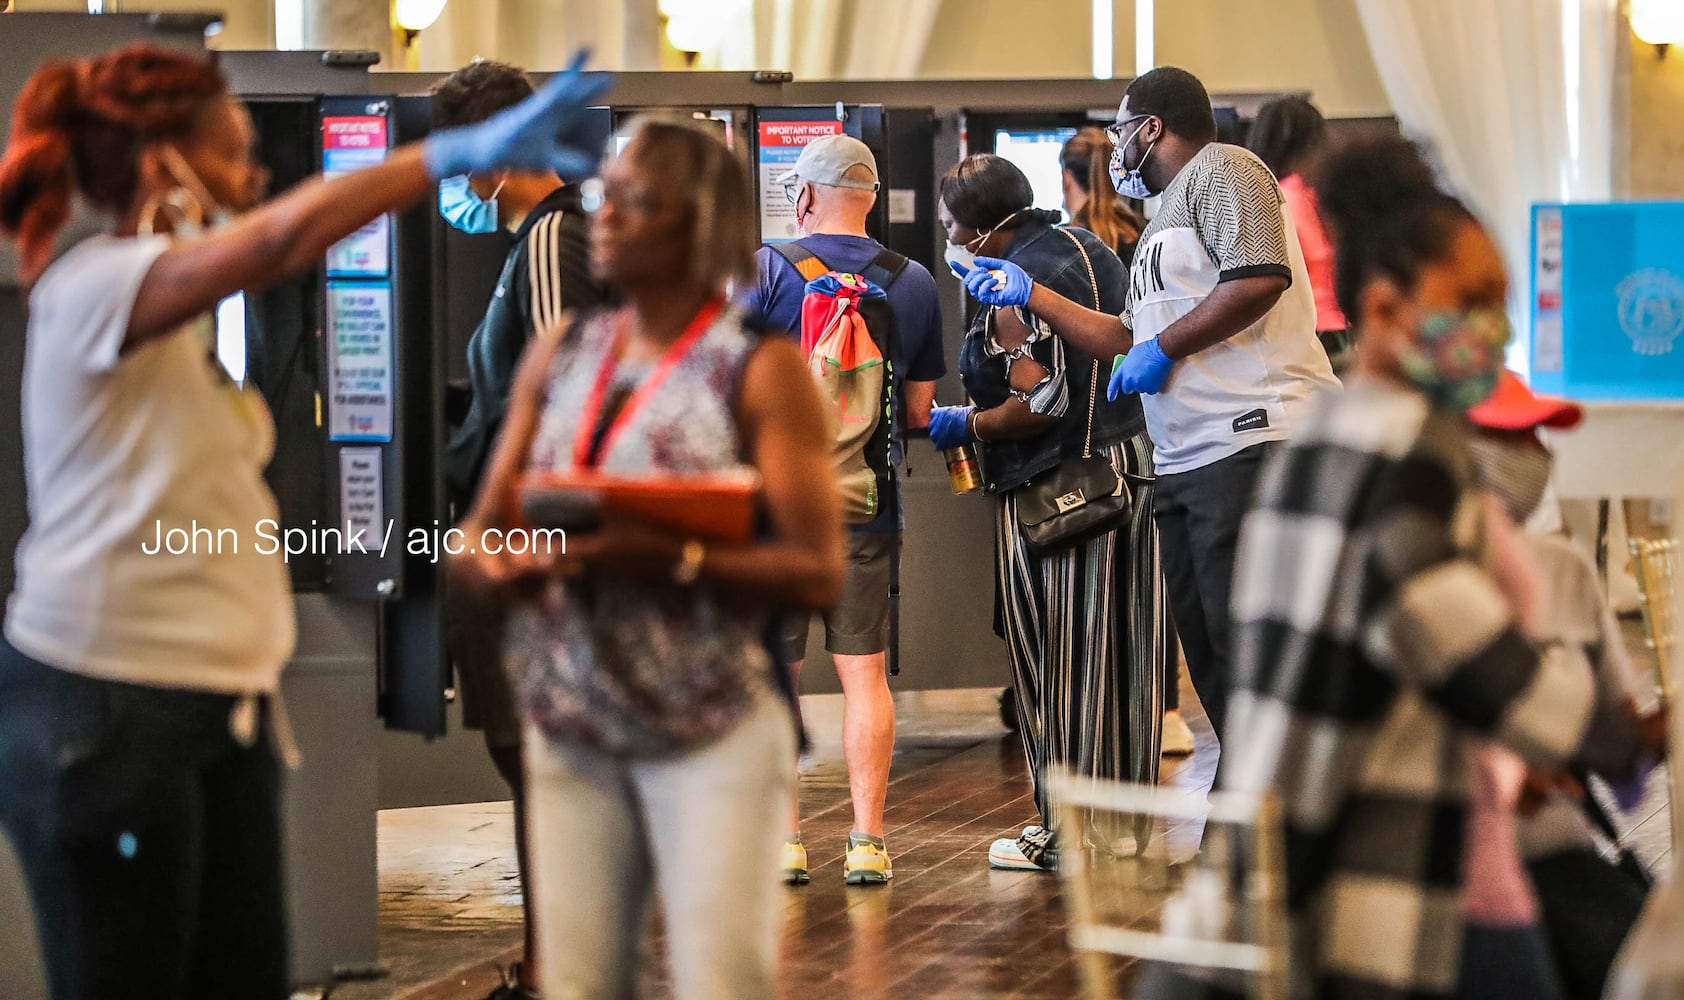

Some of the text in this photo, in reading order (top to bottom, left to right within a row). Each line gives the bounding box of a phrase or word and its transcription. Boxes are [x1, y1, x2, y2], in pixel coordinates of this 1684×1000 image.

[766, 125, 836, 135] IMPORTANT NOTICE
[781, 135, 792, 144] TO
